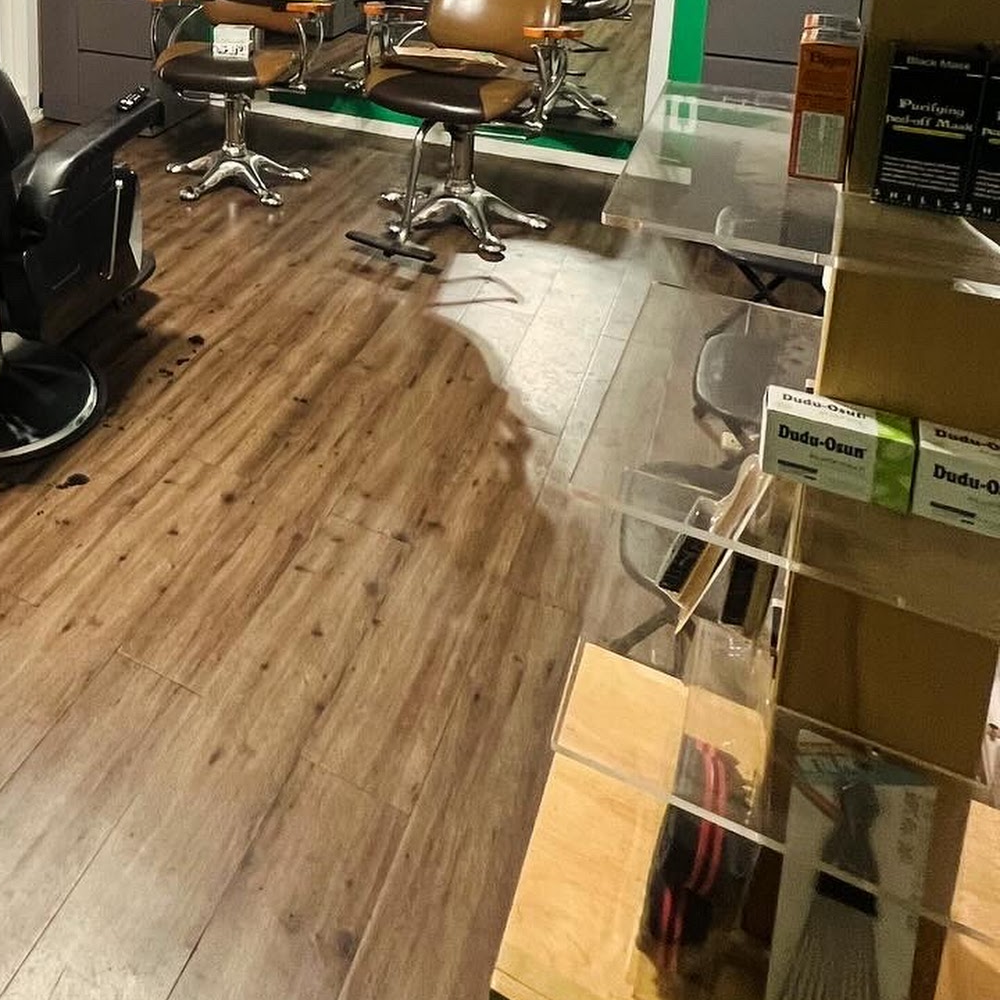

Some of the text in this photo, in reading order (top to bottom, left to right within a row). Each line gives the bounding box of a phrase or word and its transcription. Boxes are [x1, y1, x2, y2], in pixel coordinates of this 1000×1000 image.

[899, 98, 965, 118] Purifying
[935, 118, 973, 132] Mask
[782, 393, 867, 420] Dudu-Osun
[778, 424, 865, 460] Dudu-Osun
[935, 428, 1000, 451] Dudu-O
[933, 463, 1000, 495] Dudu-O
